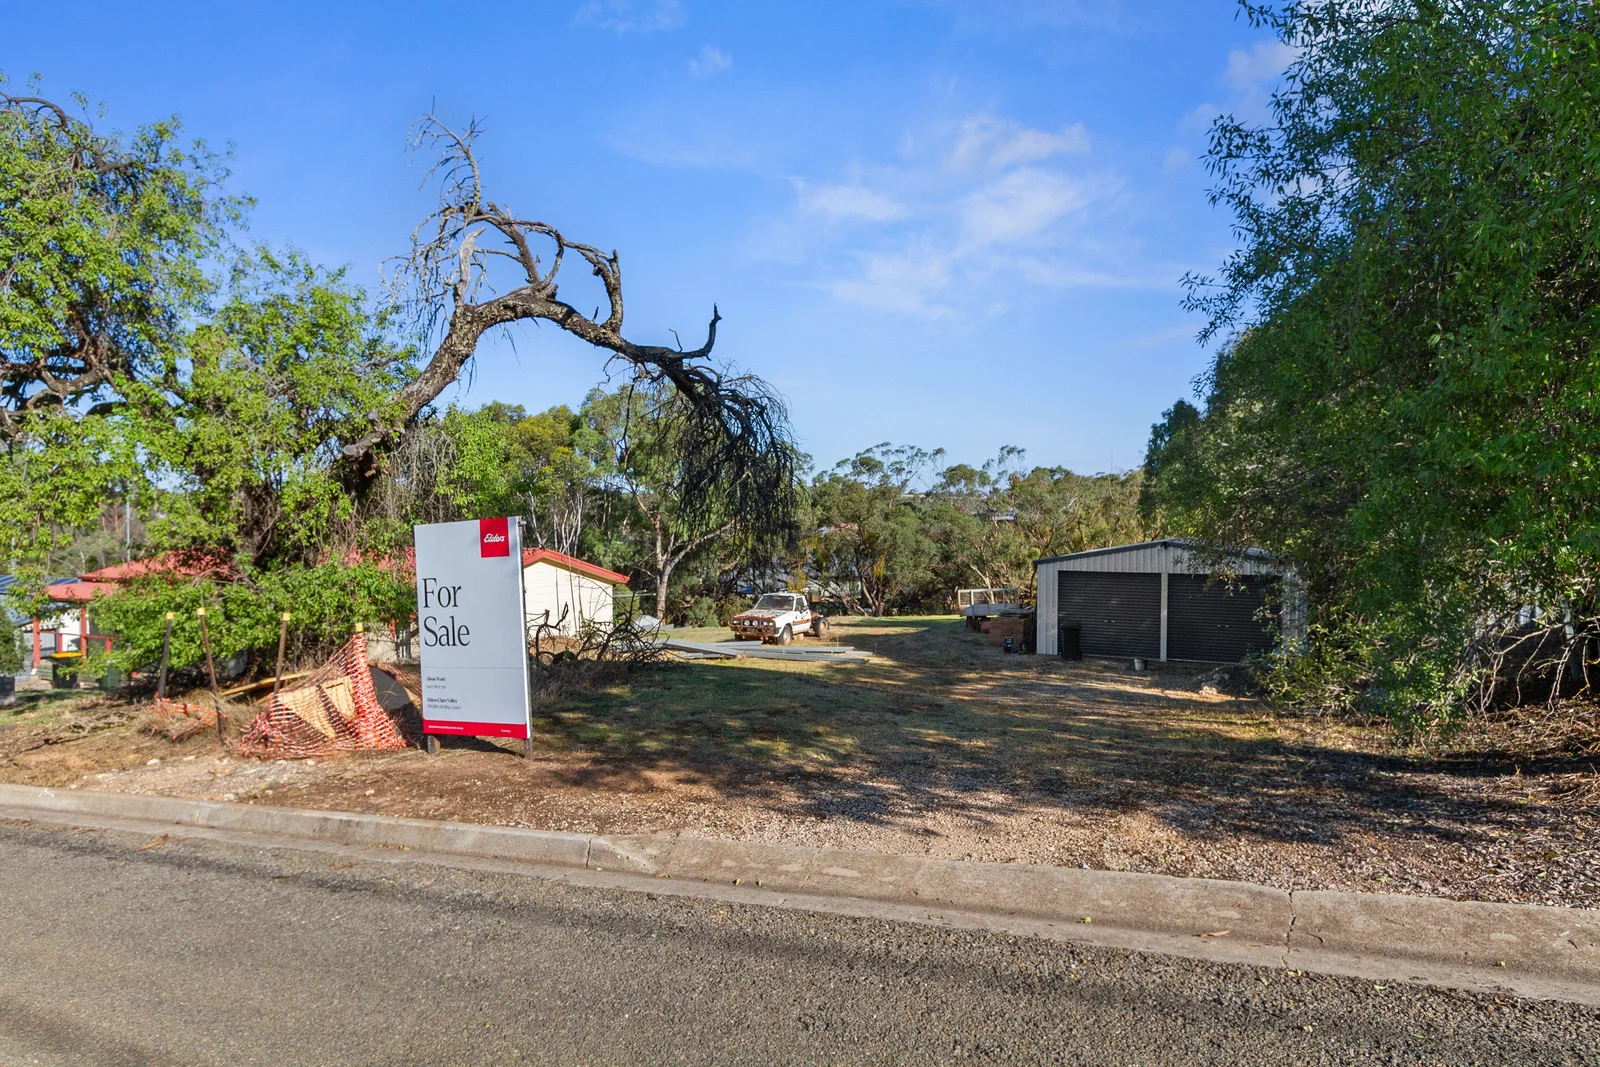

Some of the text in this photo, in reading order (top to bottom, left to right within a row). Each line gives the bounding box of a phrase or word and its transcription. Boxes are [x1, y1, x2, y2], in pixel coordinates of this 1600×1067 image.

[483, 533, 505, 543] Elders
[422, 577, 462, 608] For
[423, 615, 471, 647] Sale
